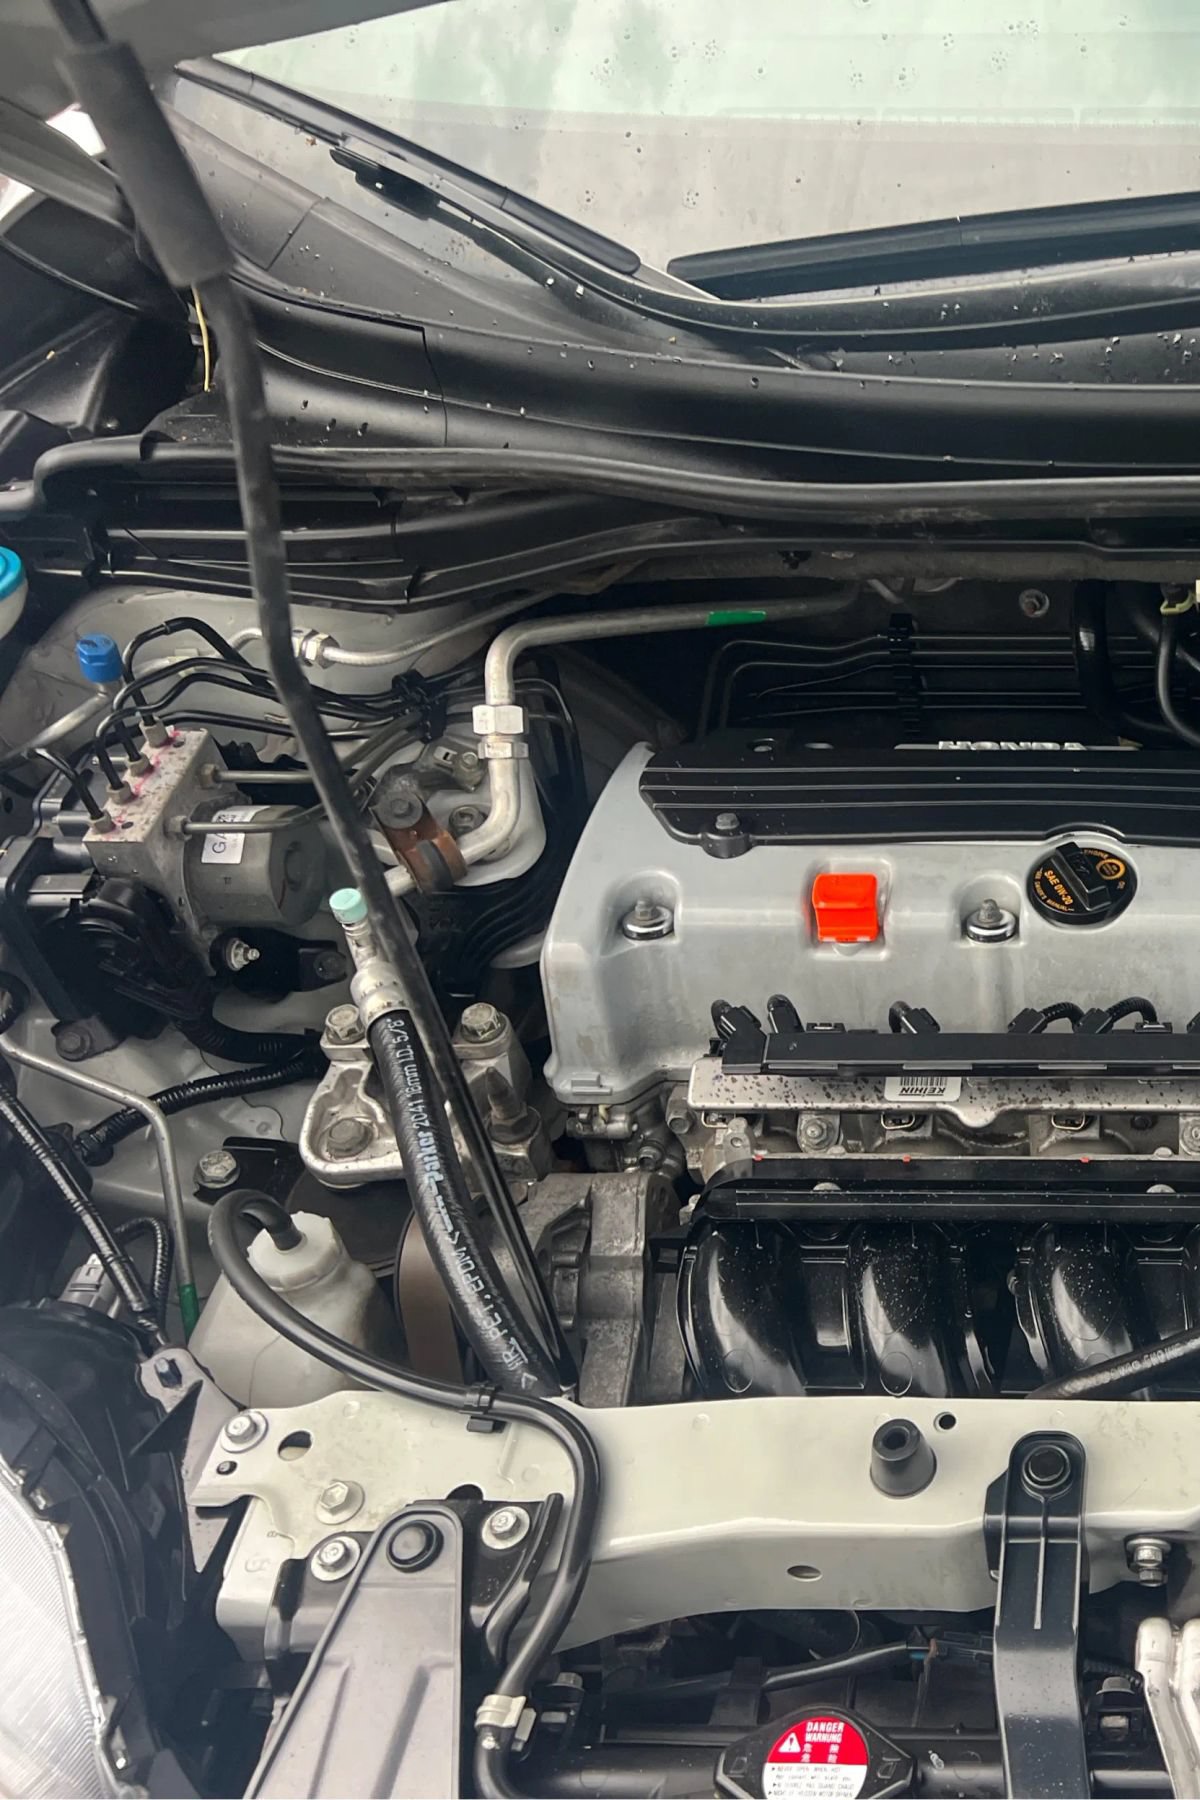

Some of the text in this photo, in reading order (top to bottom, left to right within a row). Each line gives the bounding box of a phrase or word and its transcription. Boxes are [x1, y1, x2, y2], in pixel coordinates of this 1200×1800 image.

[1044, 870, 1073, 905] SAE 0W-20
[900, 1087, 946, 1095] KEIHIN
[407, 1100, 430, 1129] 2041
[416, 1130, 445, 1184] Parker
[806, 1722, 844, 1732] DANGER
